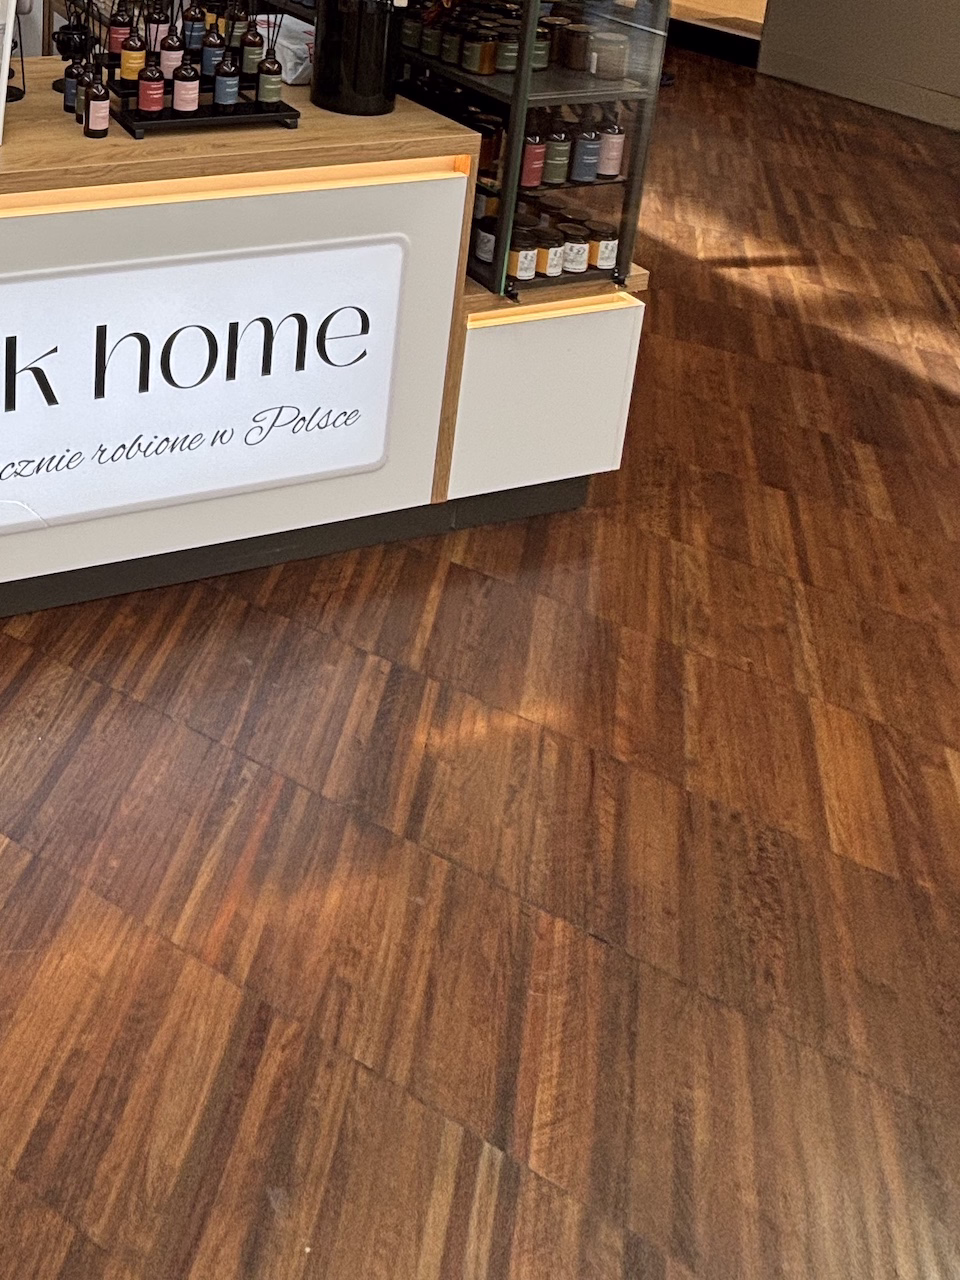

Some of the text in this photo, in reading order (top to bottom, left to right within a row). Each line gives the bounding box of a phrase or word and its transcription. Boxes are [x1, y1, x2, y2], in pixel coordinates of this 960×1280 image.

[94, 305, 371, 401] home
[91, 433, 206, 466] robione
[210, 427, 235, 447] w
[243, 405, 362, 446] Polsce
